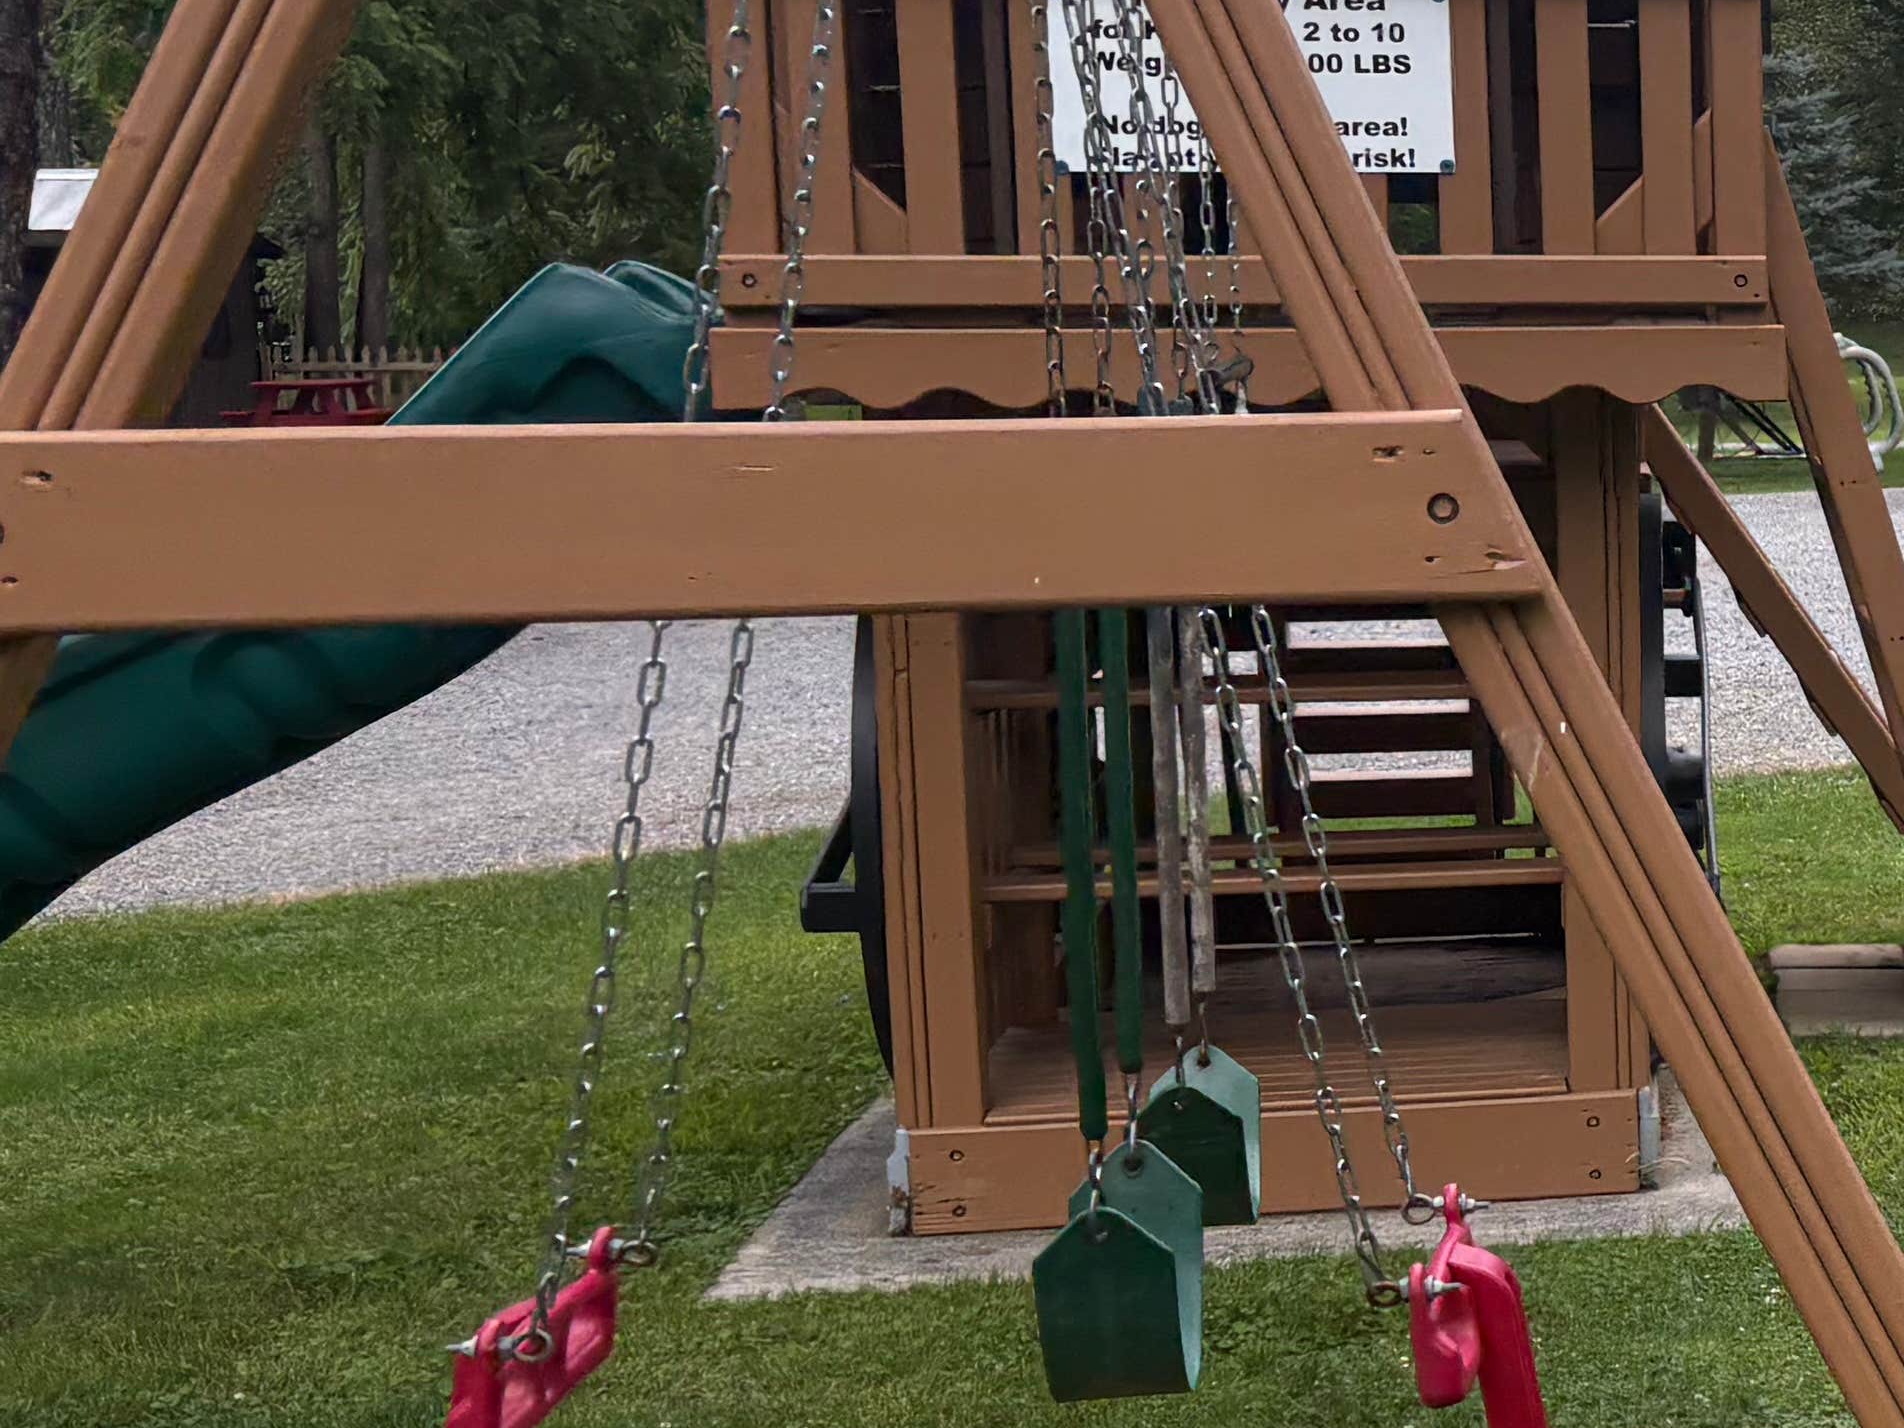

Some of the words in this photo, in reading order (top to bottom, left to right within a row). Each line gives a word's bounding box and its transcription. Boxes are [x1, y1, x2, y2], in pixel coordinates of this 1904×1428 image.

[1303, 22, 1320, 42] 2
[1330, 23, 1360, 42] to
[1371, 23, 1405, 43] 10
[1308, 53, 1343, 74] 00
[1354, 54, 1412, 74] LBS
